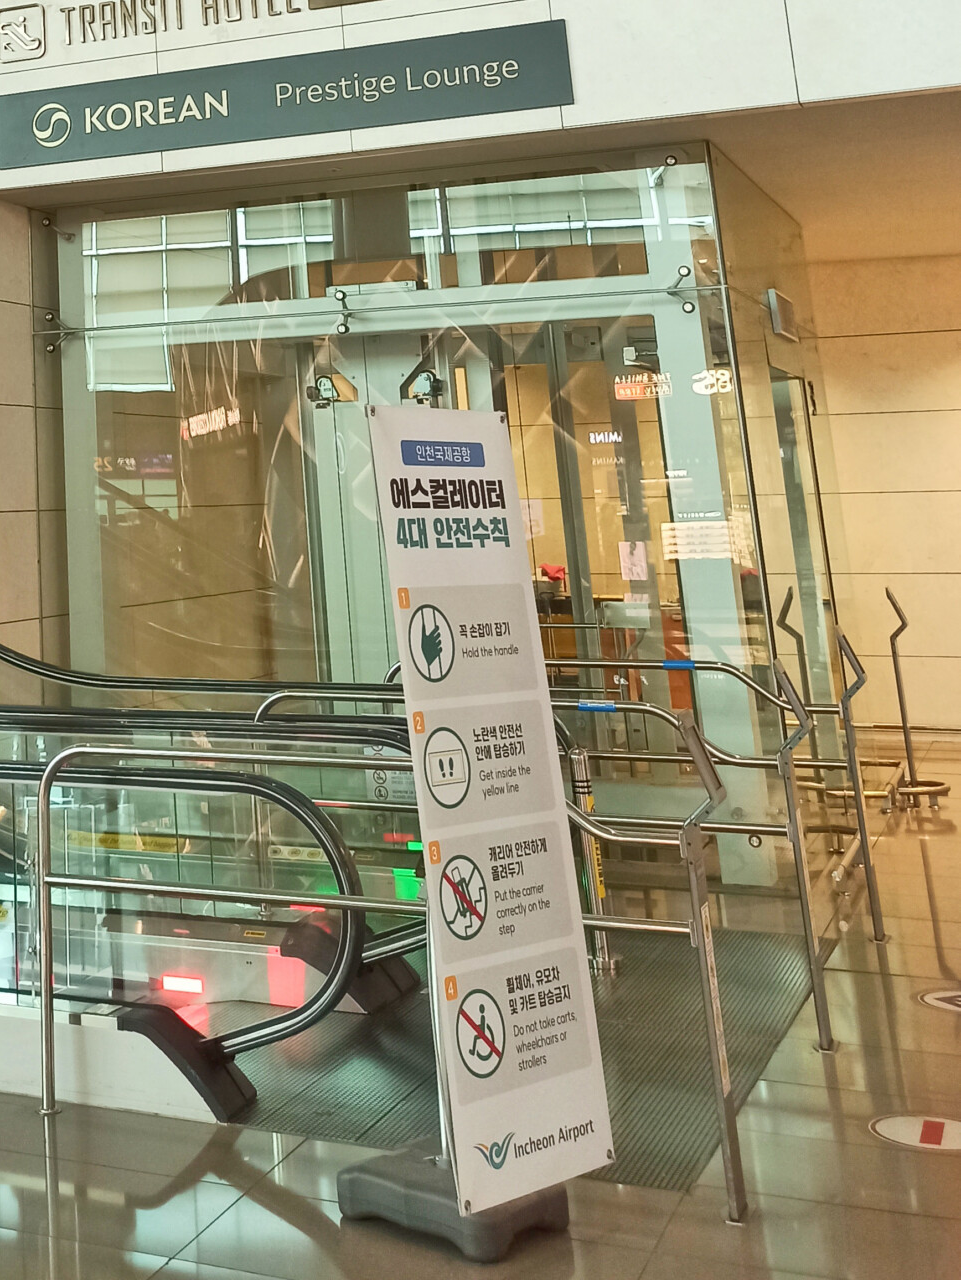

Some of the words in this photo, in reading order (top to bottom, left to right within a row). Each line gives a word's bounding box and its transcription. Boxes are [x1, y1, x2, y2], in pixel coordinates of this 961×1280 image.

[83, 89, 230, 135] KOREAN
[274, 72, 397, 108] Prestige
[405, 55, 520, 92] Lounge
[416, 445, 471, 463] 인천국제공항
[390, 478, 506, 510] 에스컬레이터
[396, 517, 429, 549] 4대
[432, 516, 511, 549] 안전수칙
[459, 623, 468, 639] 꼭
[469, 622, 494, 639] 손잡이
[494, 621, 511, 637] 잡기
[462, 646, 480, 659] Hold
[480, 645, 493, 657] the
[494, 644, 519, 657] handle
[415, 716, 422, 730] 2
[472, 725, 498, 743] 노란색
[498, 723, 523, 739] 안전선
[475, 743, 493, 762] 안에
[493, 740, 526, 760] 탑승하기
[479, 769, 494, 782] Get
[495, 767, 517, 780] inside
[517, 765, 531, 777] the
[482, 783, 506, 801] yellow
[506, 782, 520, 795] line
[432, 846, 438, 860] 3
[488, 843, 514, 862] 캐리어
[514, 837, 548, 858] 안전하게
[491, 860, 524, 882] 올려두기
[494, 889, 508, 903] Put
[508, 887, 522, 900] the
[522, 883, 545, 898] carrier
[496, 903, 527, 919] correctly
[527, 901, 538, 912] on
[538, 898, 551, 910] the
[498, 923, 516, 937] step
[447, 981, 454, 996] 4
[505, 972, 535, 995] 휠체어,
[535, 965, 560, 986] 유모차
[509, 998, 519, 1016] 및
[519, 993, 538, 1013] 카트
[538, 984, 571, 1008] 탑승금지
[513, 1024, 525, 1038] Do
[525, 1021, 539, 1035] not
[539, 1016, 556, 1030] take
[556, 1010, 578, 1026] carts,
[515, 1032, 559, 1055] wheelchairs
[559, 1030, 568, 1042] or
[518, 1053, 548, 1072] strollers
[513, 1134, 556, 1159] Incheon
[558, 1119, 595, 1144] Airport
